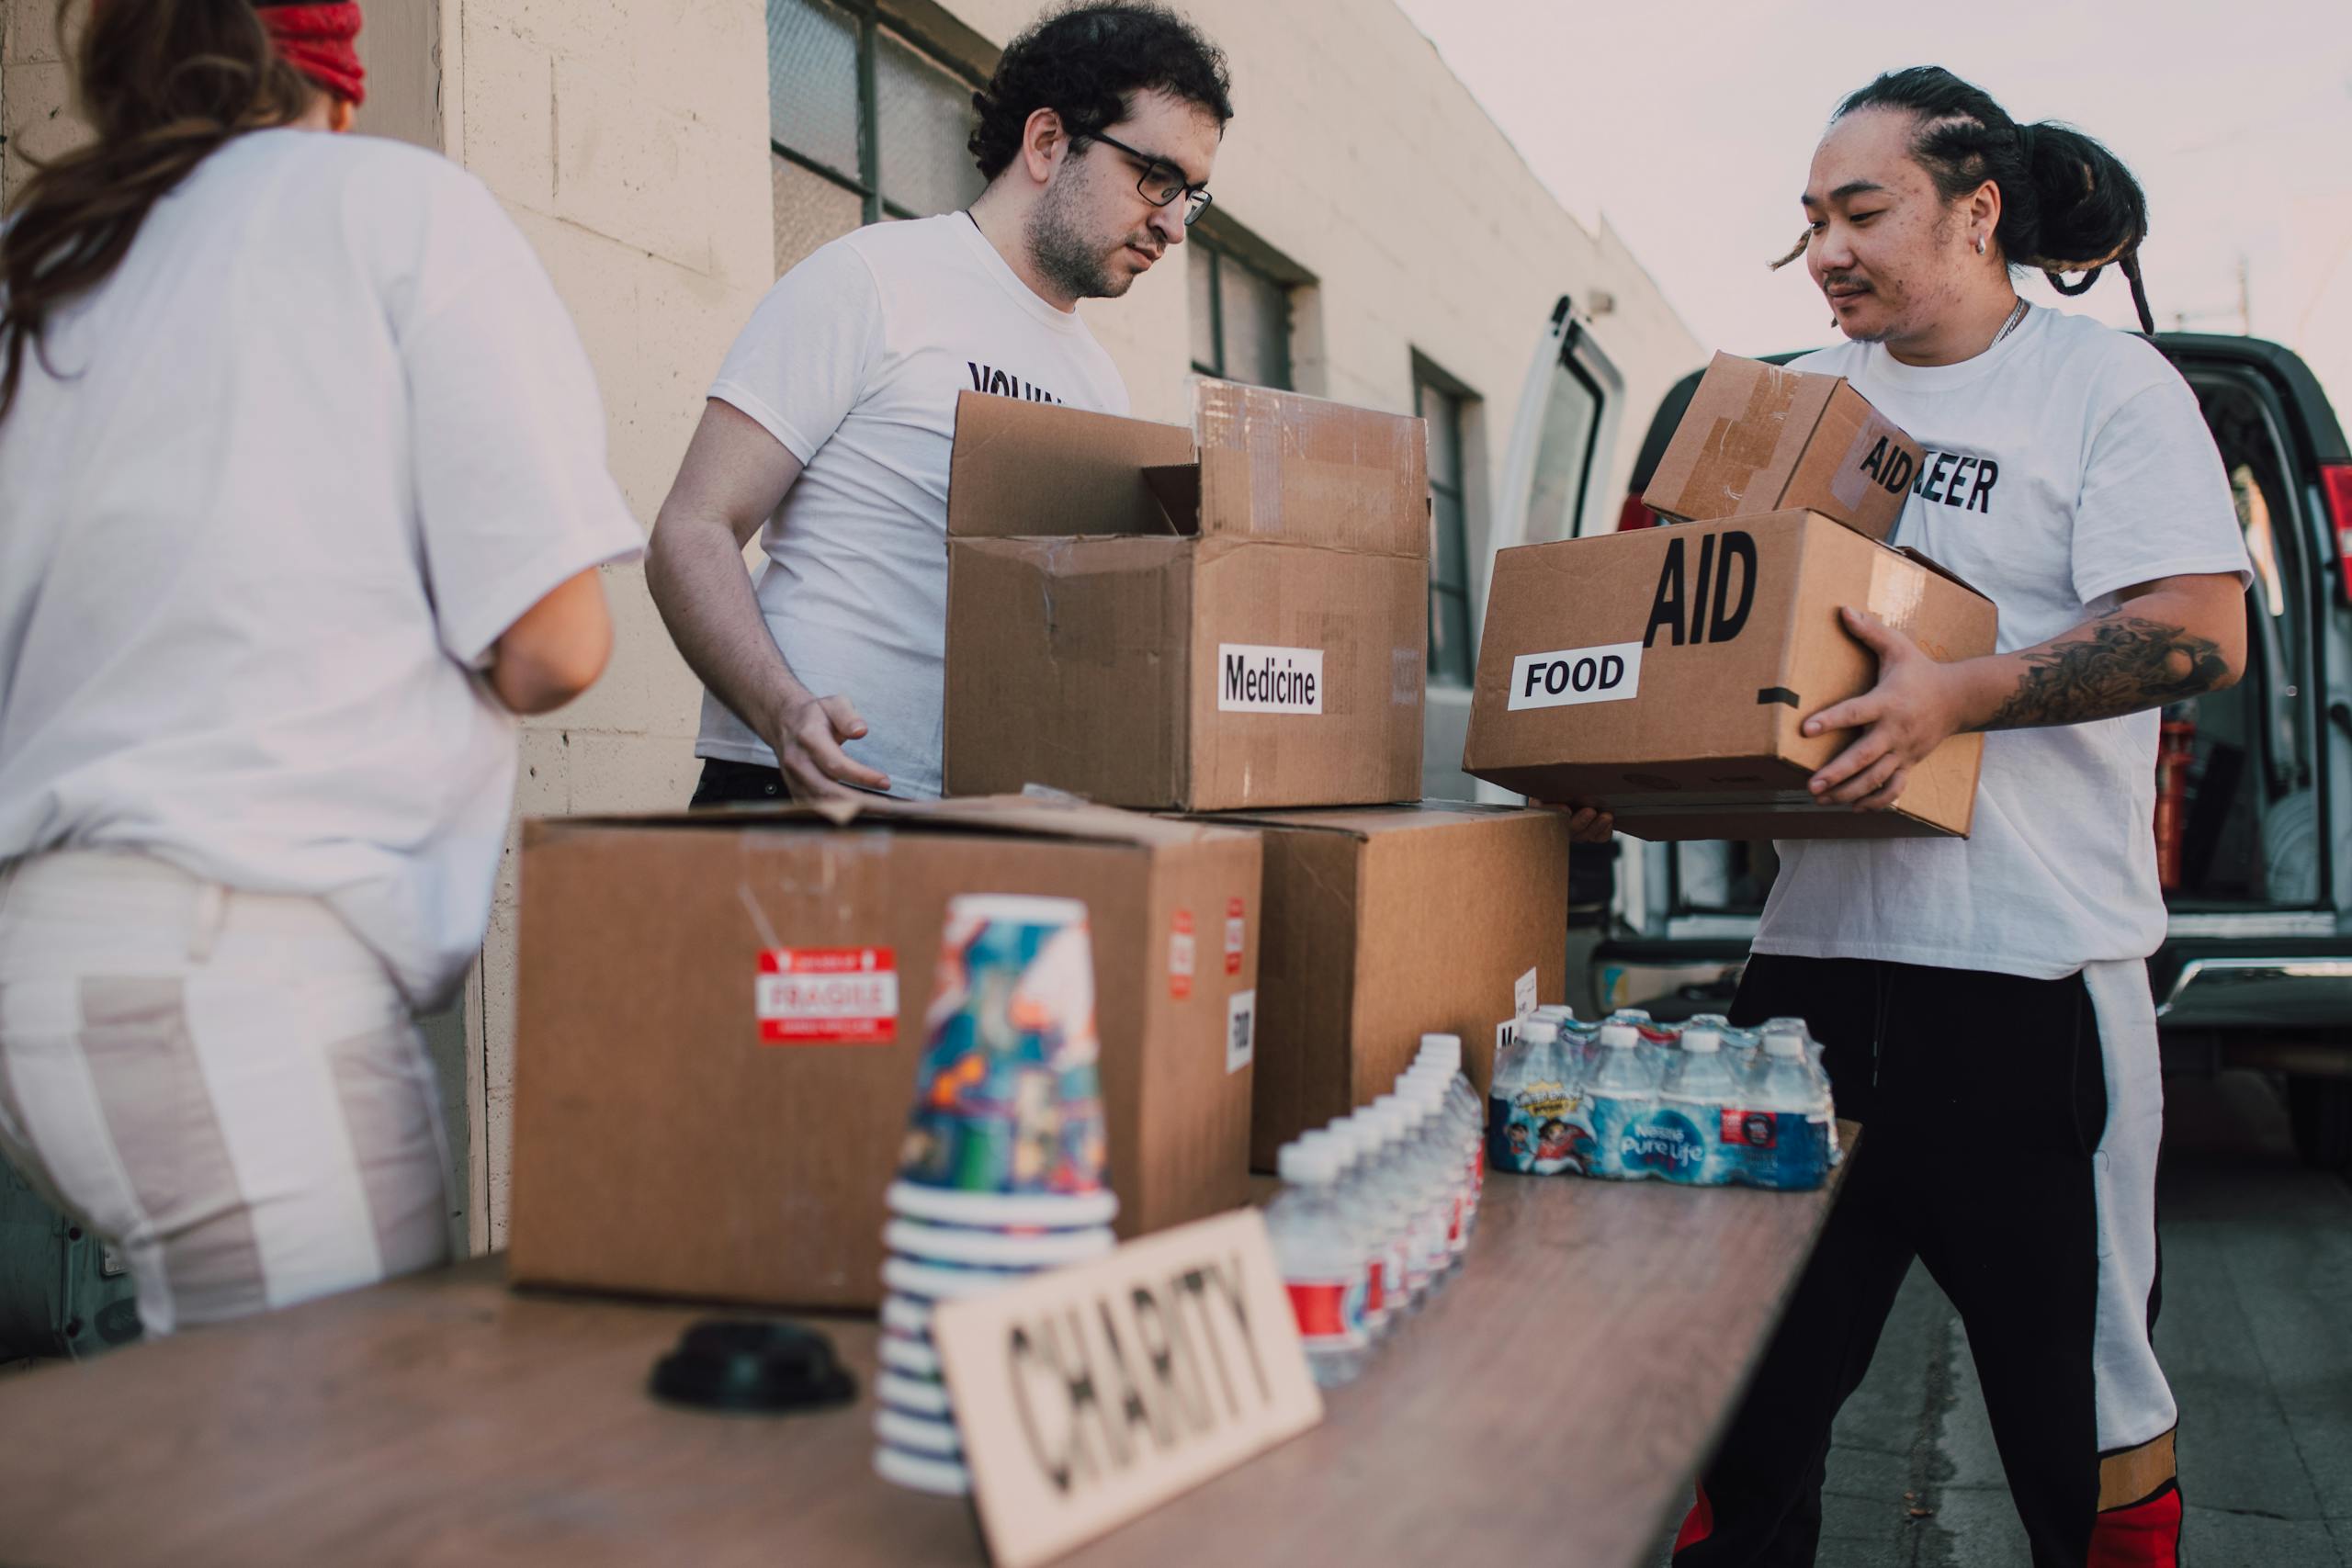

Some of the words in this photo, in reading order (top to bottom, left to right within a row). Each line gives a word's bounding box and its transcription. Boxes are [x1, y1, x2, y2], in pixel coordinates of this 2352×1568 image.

[1859, 434, 1915, 496] AID
[1642, 530, 1758, 649] AID
[1224, 652, 1317, 706] Medicine
[1523, 654, 1625, 698] FOOD
[770, 983, 884, 1005] FRAGILE
[1005, 1248, 1275, 1494] CHARITY
